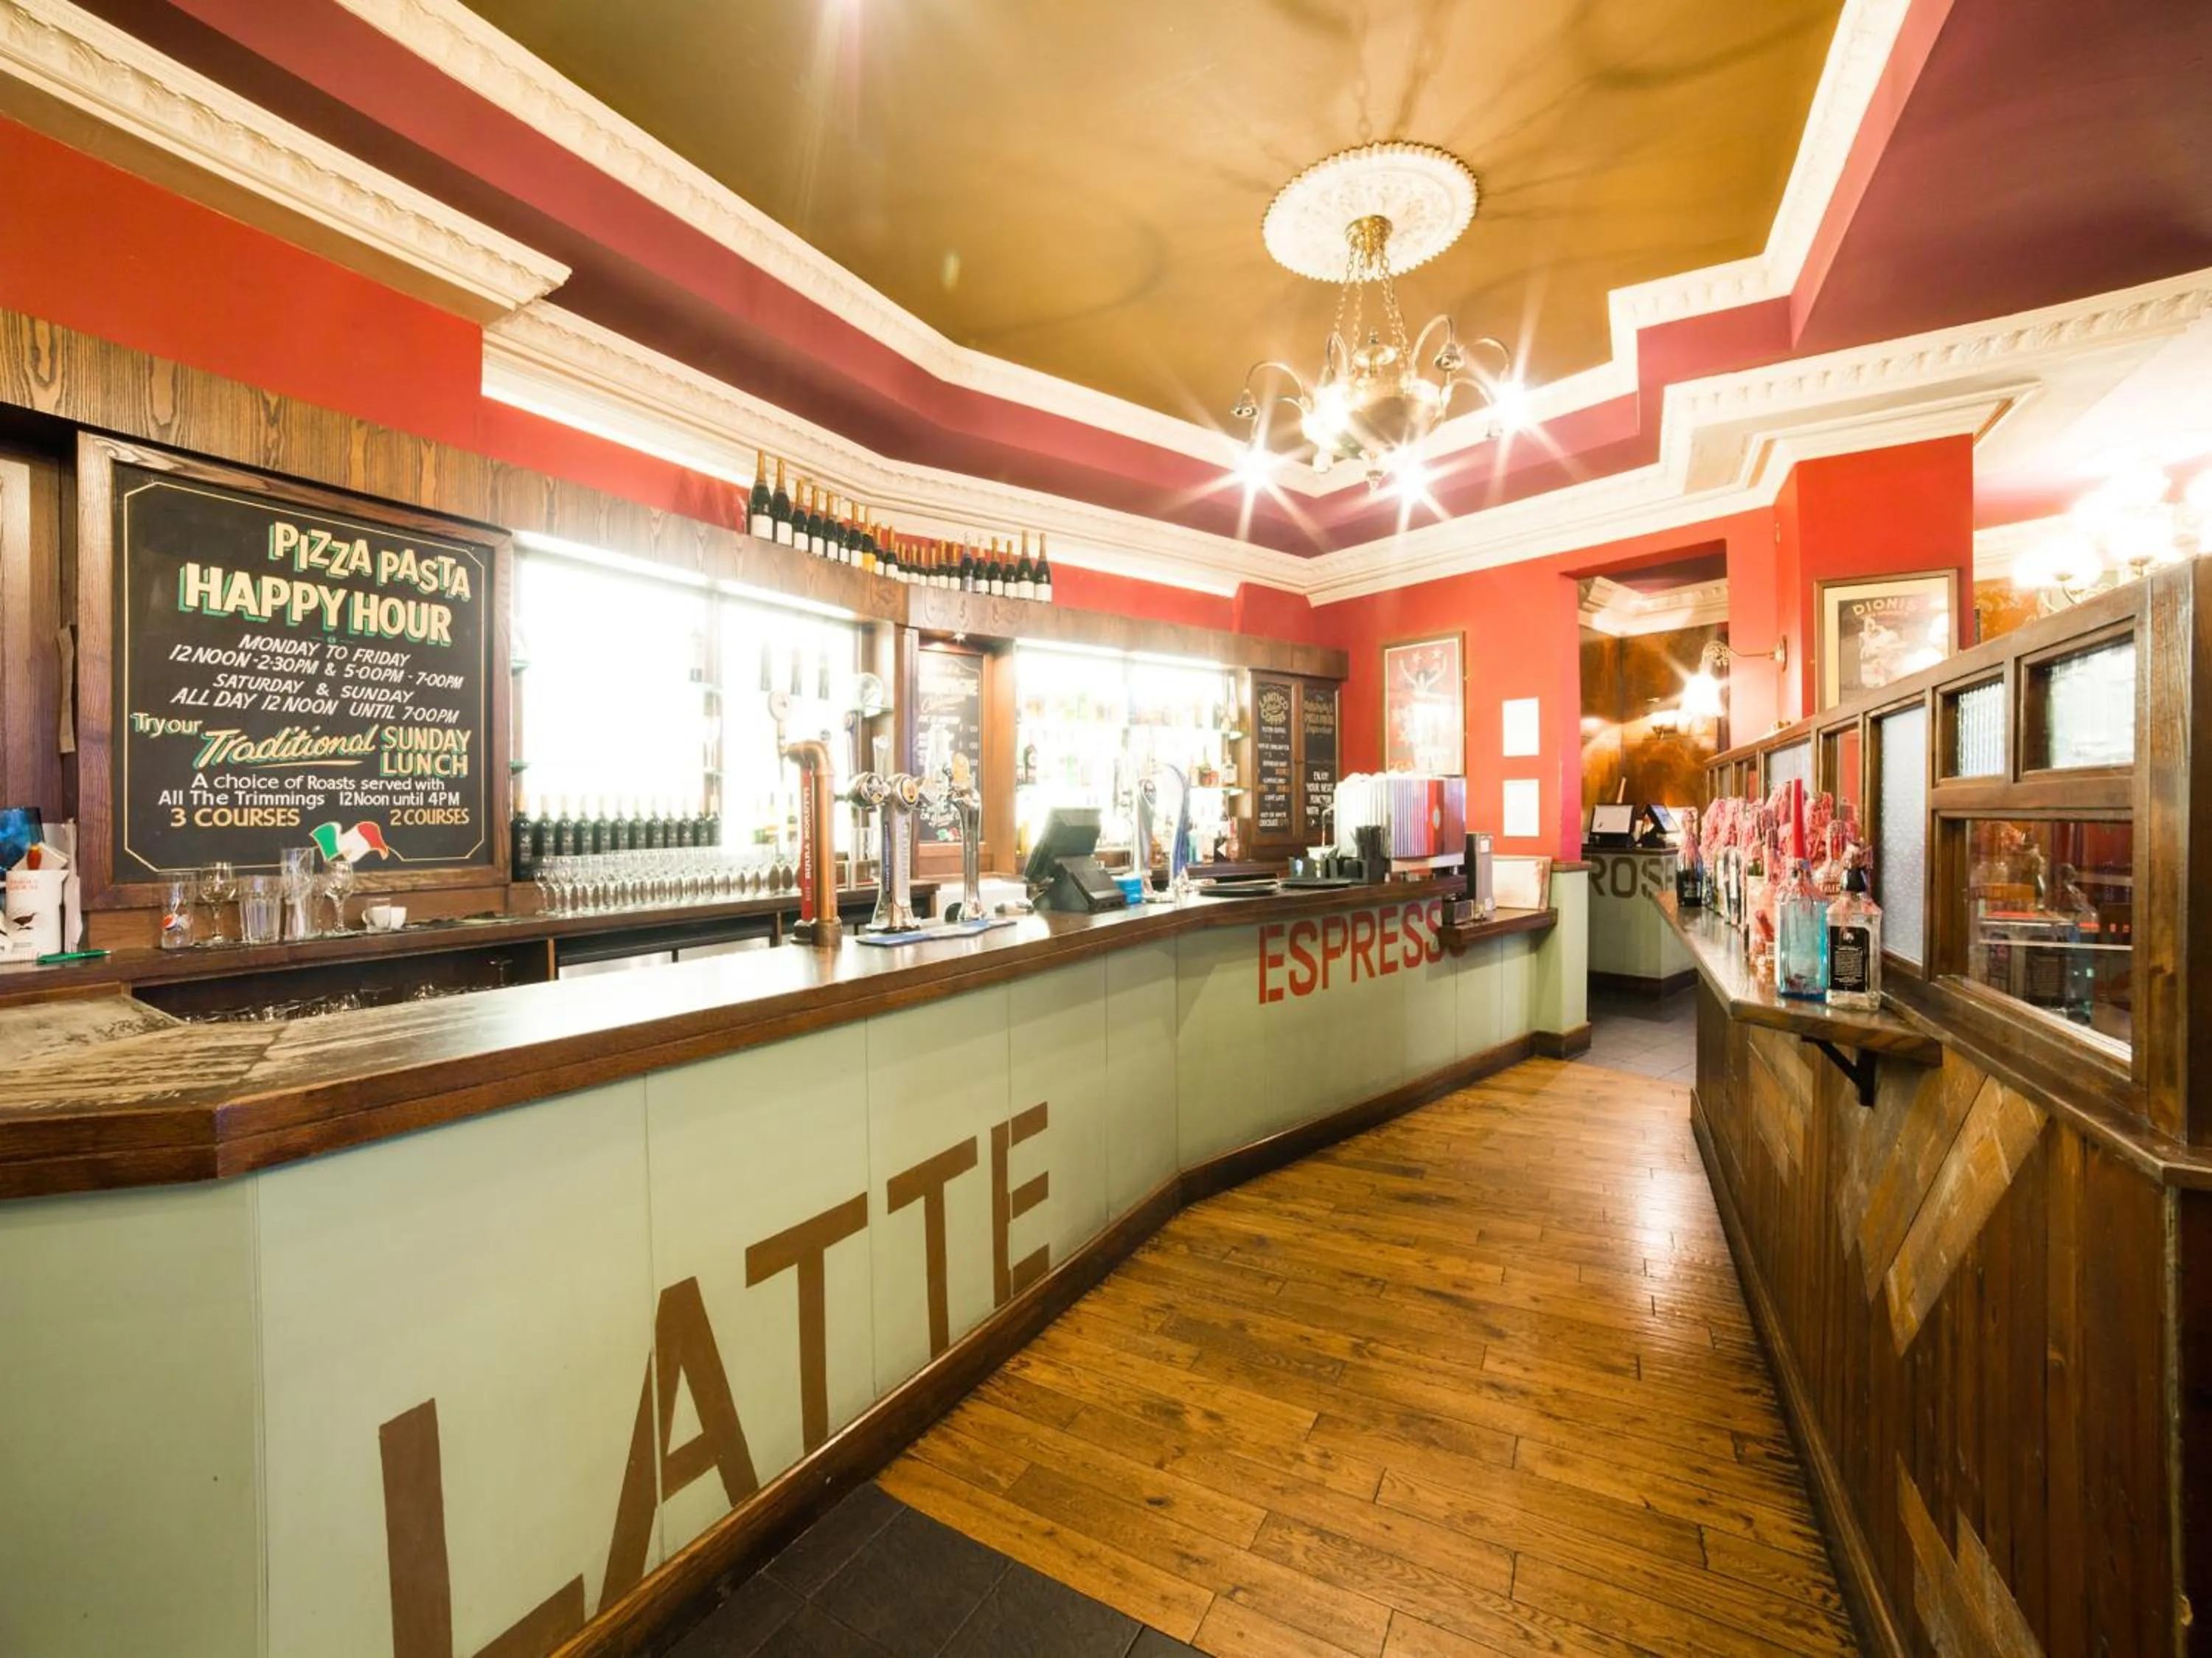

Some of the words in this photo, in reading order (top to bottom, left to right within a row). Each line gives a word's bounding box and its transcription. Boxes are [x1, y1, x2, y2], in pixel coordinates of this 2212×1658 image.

[268, 521, 372, 578] PIZZA
[377, 549, 471, 602] PASTA
[178, 562, 347, 631] HAPPY
[348, 592, 452, 647] HOUR
[191, 647, 252, 669] NOON
[324, 662, 336, 676] &
[237, 634, 320, 657] MONDAY
[326, 645, 348, 660] TO
[352, 648, 411, 667] FRIDAY
[212, 673, 305, 694] SATURDAY
[316, 682, 330, 697] &
[340, 685, 414, 703] SUNDAY
[170, 687, 210, 706] ALL
[212, 690, 257, 710] DAY
[260, 694, 281, 710] 12
[282, 696, 339, 715] NOON
[349, 701, 396, 720] UNTIL
[131, 712, 165, 738] Try
[165, 718, 203, 735] our
[192, 723, 380, 769] Traditional
[380, 726, 473, 754] SUNDAY
[380, 752, 469, 778] LUNCH
[191, 773, 209, 788] A
[213, 773, 279, 789] choice
[284, 775, 304, 789] of
[307, 775, 356, 790] Roasts
[361, 776, 411, 790] served
[415, 777, 445, 791] with
[158, 790, 184, 805] All
[189, 790, 229, 805] The
[234, 790, 325, 810] Trimmings
[393, 791, 424, 806] until
[428, 791, 460, 806] 4PM
[170, 808, 187, 827] 3
[194, 808, 301, 827] COURSES
[390, 809, 402, 826] 2
[403, 808, 470, 825] COURSES
[378, 1101, 1050, 1658] LATTE
